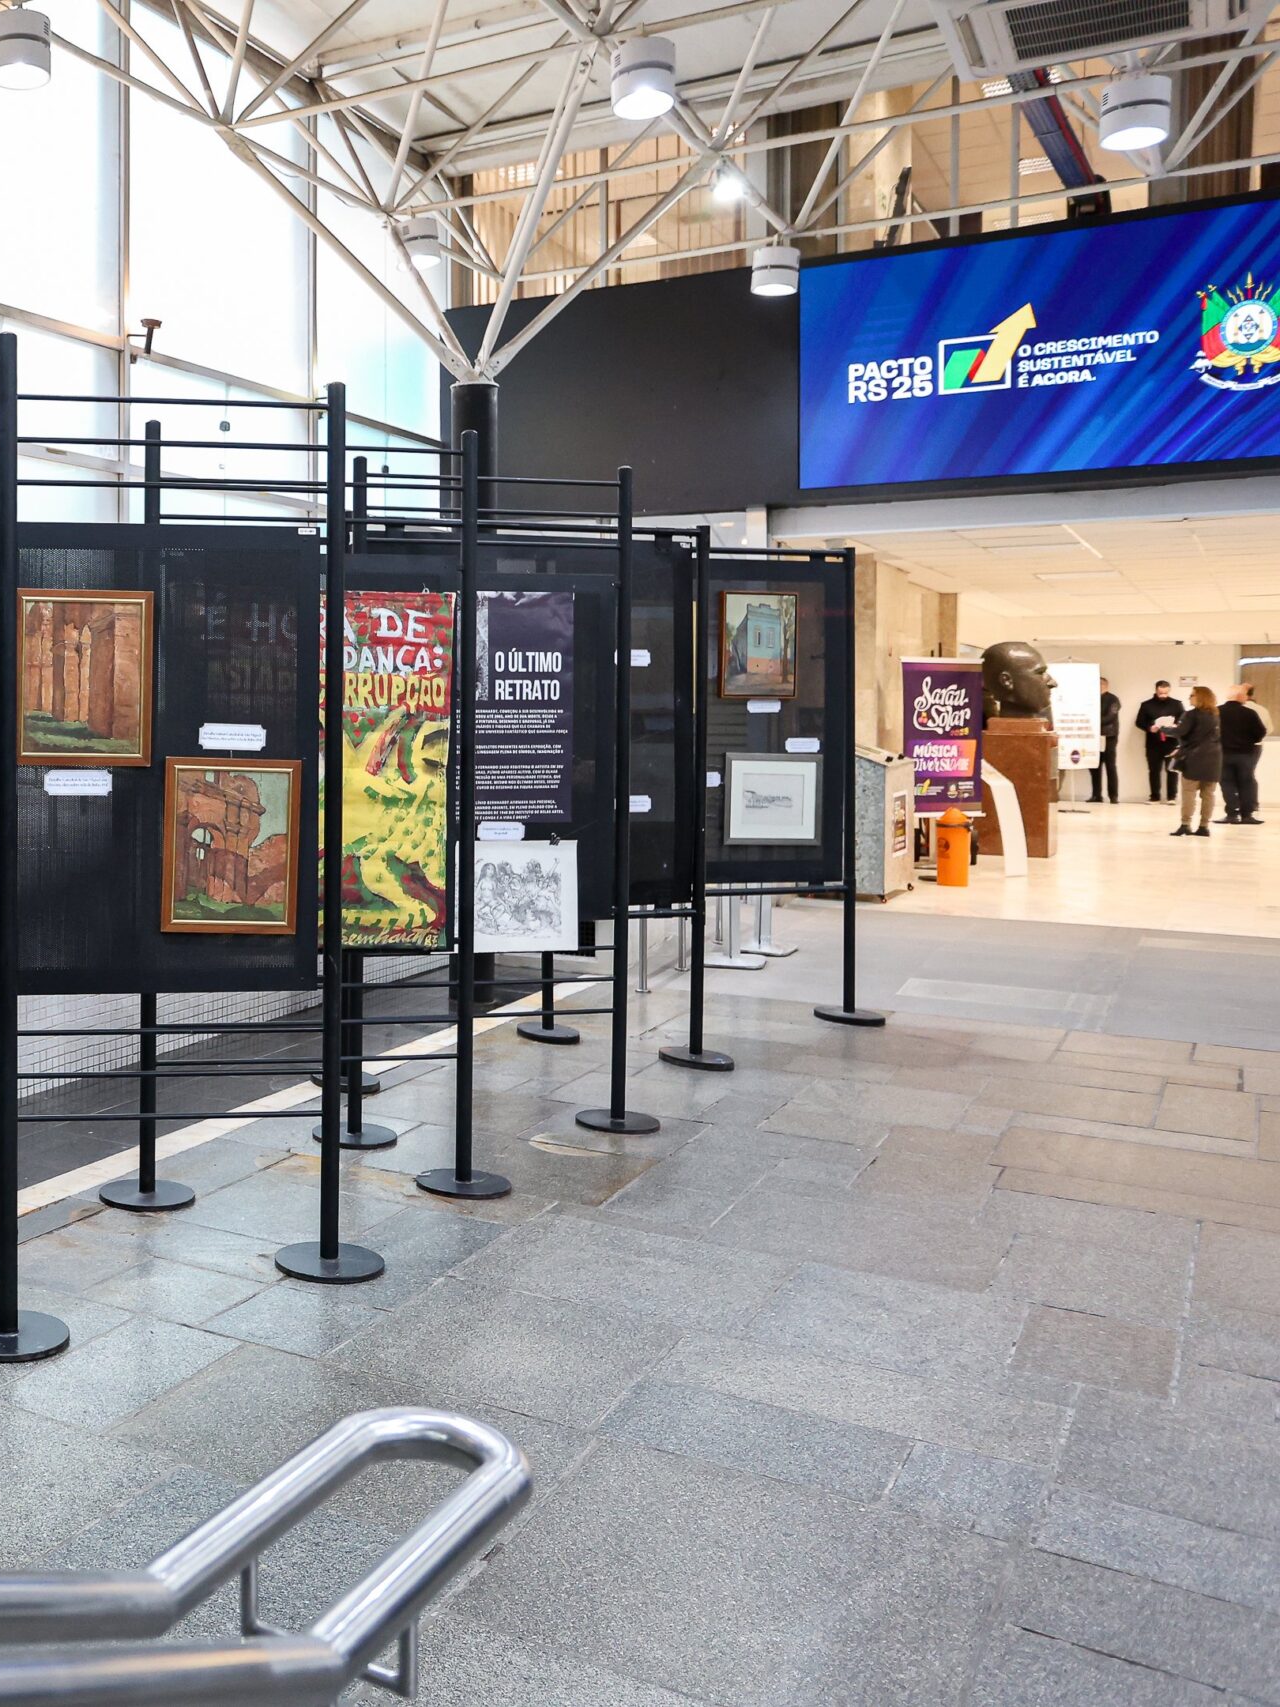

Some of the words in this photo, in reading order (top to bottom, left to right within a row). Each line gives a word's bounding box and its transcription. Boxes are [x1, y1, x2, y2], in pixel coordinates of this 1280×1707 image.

[1018, 343, 1030, 357] O
[1033, 330, 1159, 355] CRESCIMENTO
[848, 356, 933, 382] PACTO
[1018, 349, 1136, 373] SUSTENTÁVEL
[848, 381, 887, 404] RS
[892, 375, 933, 400] 25
[1018, 373, 1029, 389] É
[1030, 371, 1097, 387] AGORA.
[371, 607, 433, 643] DE
[494, 651, 506, 673] O
[508, 648, 562, 673] ÚLTIMO
[494, 680, 561, 701] RETRATO
[914, 676, 969, 711] Sarau
[927, 704, 971, 731] Solar
[913, 742, 958, 758] MÚSICA
